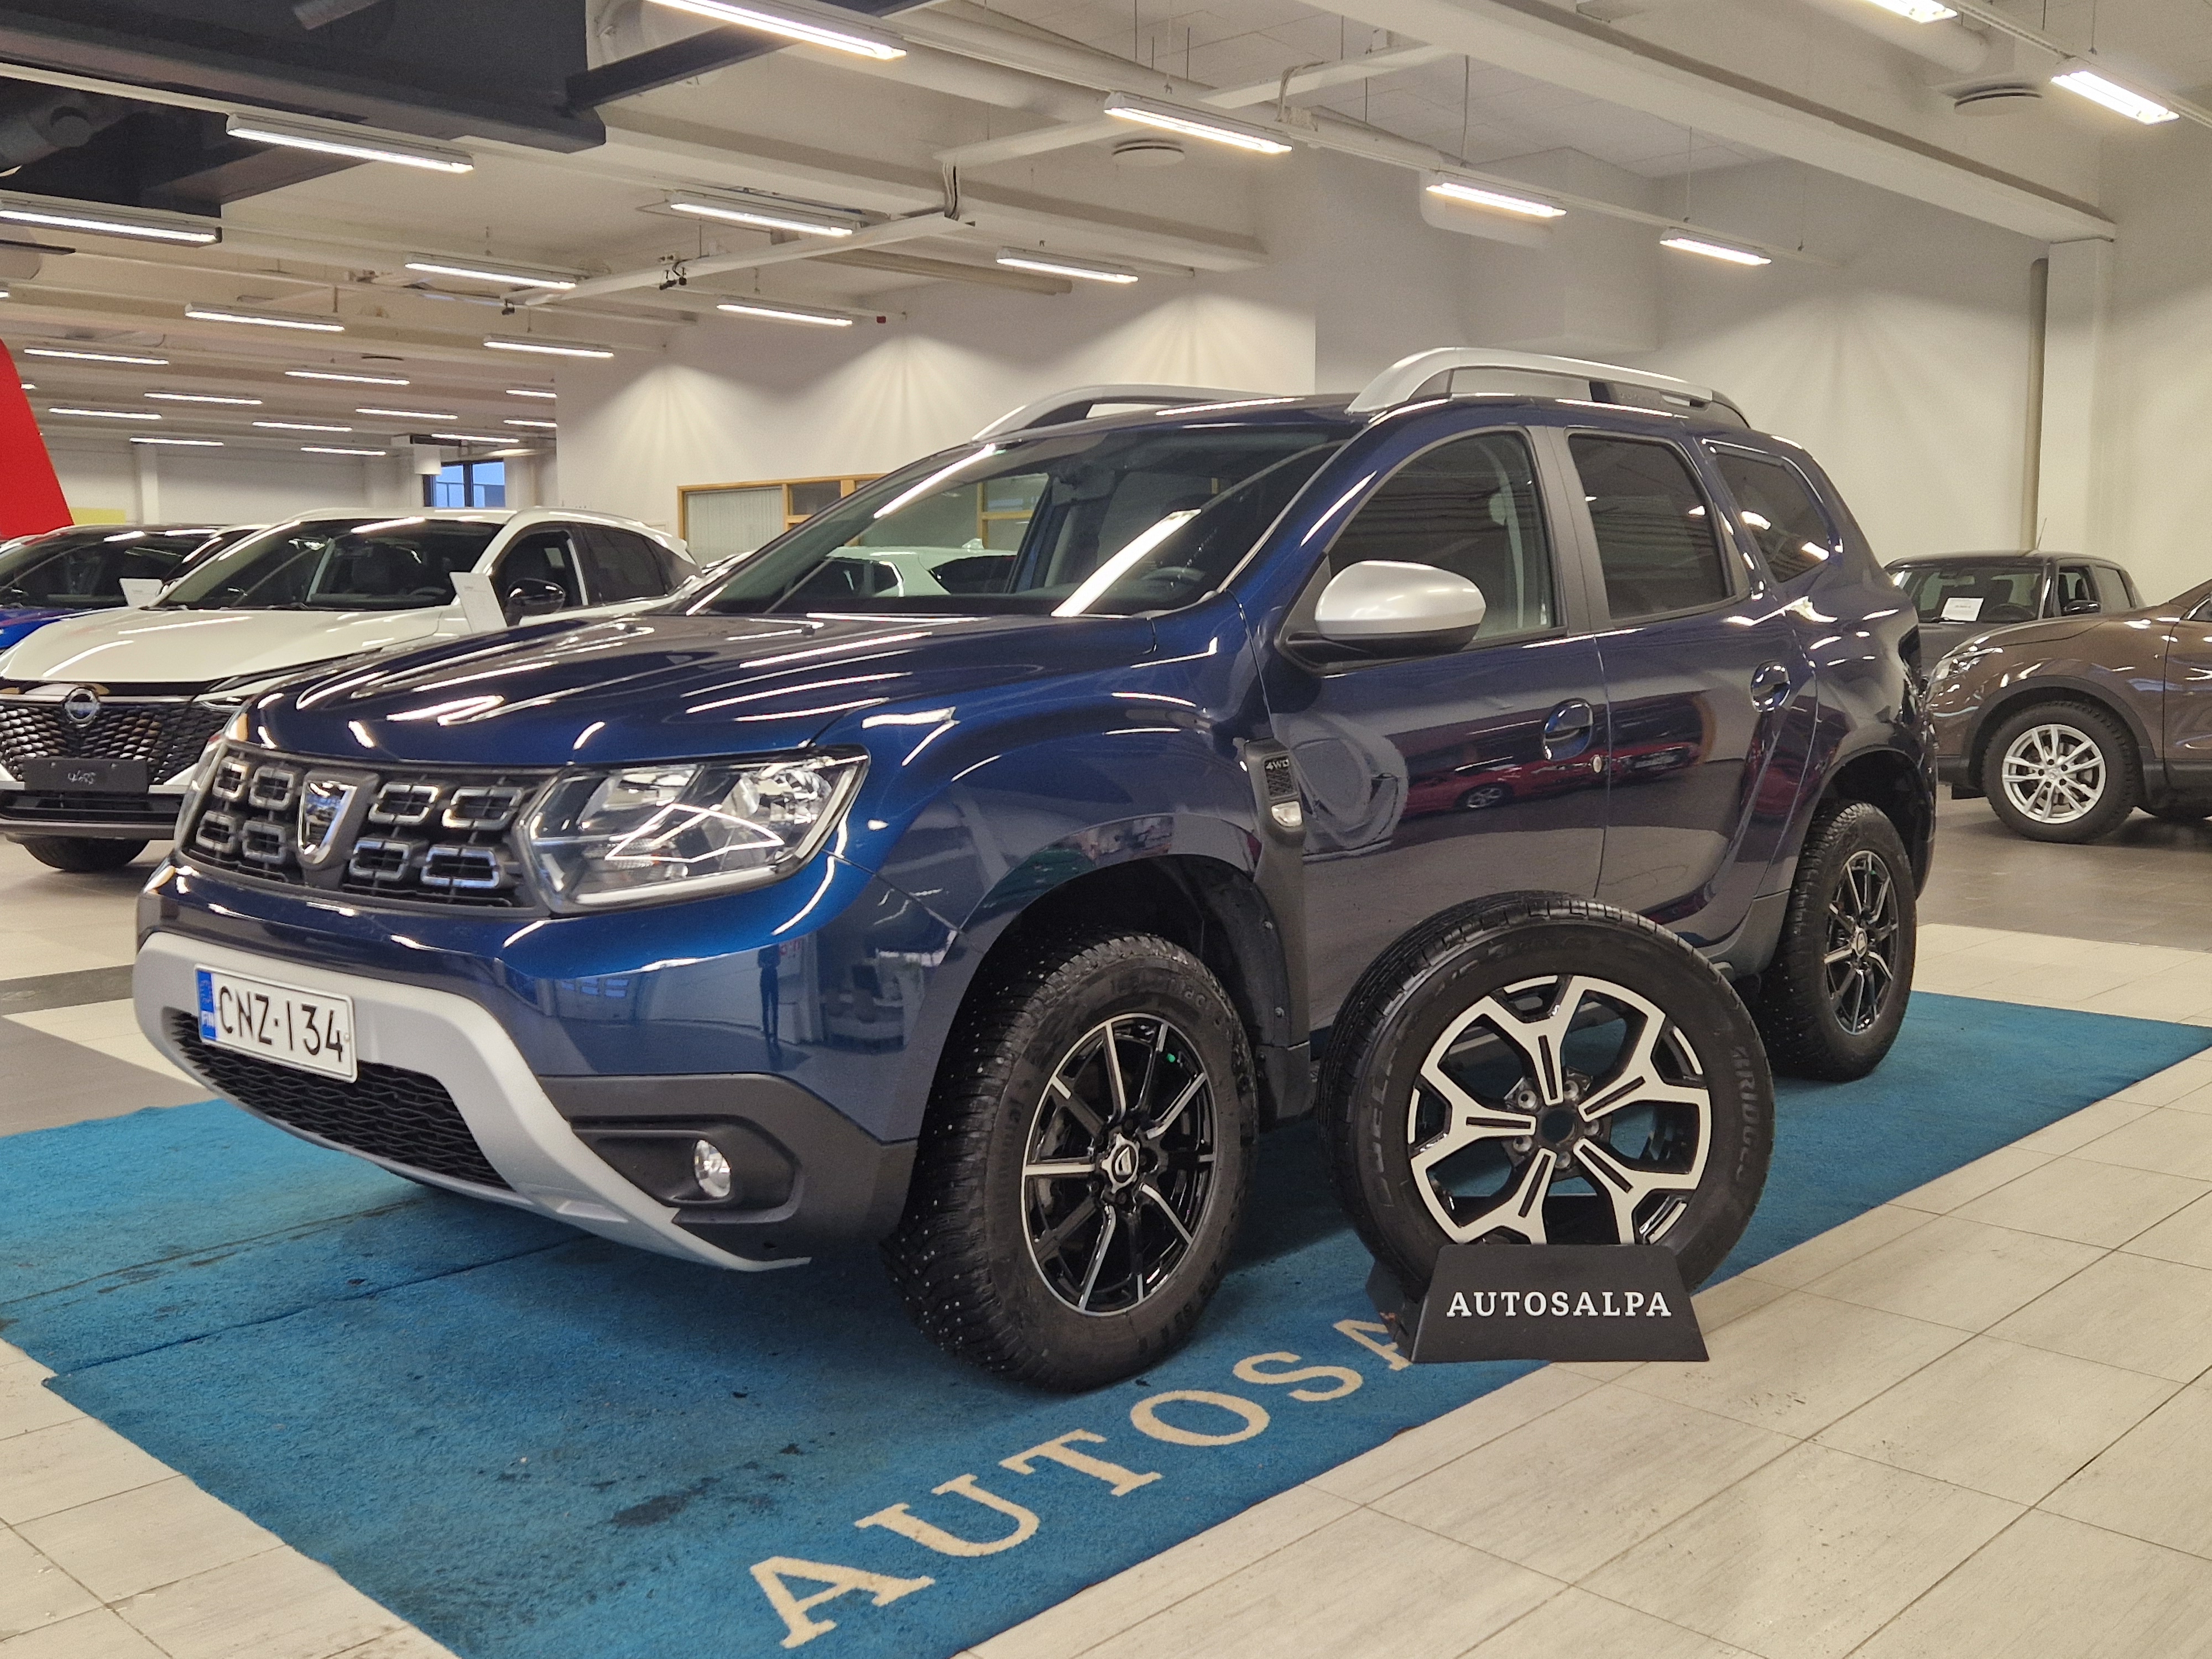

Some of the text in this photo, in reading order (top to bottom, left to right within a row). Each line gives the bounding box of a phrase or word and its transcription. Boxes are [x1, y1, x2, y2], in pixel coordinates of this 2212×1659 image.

[1266, 758, 1290, 770] 4WD
[218, 985, 343, 1062] CNZ-134
[1446, 1291, 1672, 1317] AUTOSALPA
